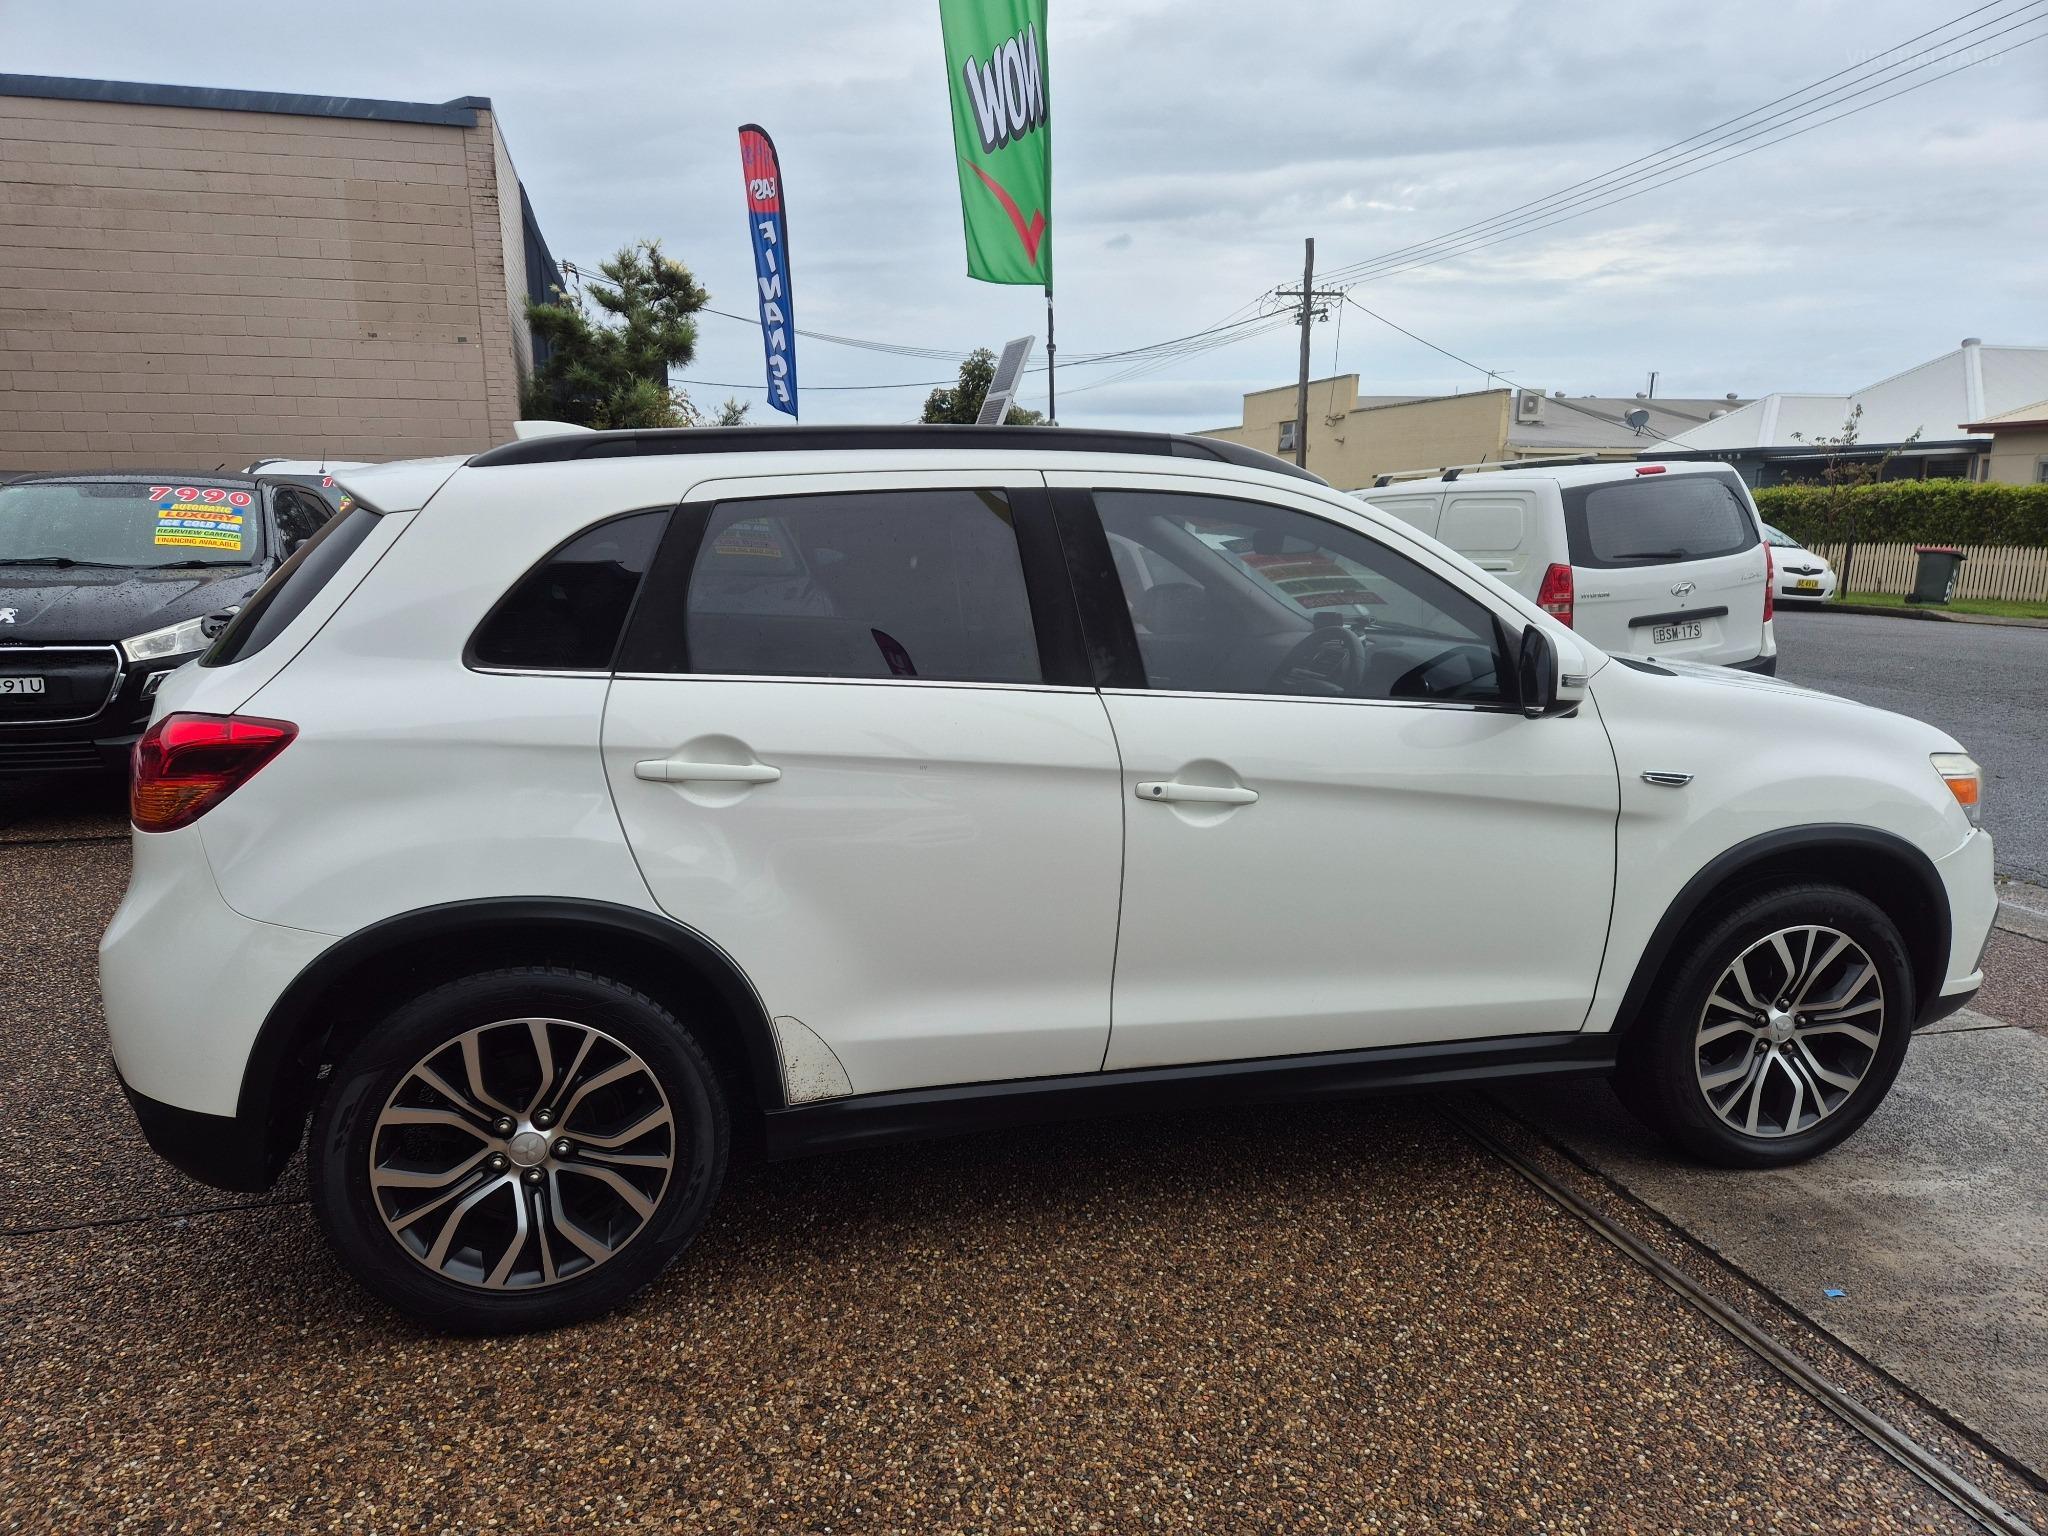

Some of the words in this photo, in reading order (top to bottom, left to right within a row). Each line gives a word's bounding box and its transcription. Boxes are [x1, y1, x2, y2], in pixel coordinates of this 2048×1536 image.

[149, 486, 252, 507] 7990
[170, 503, 234, 514] AUTOMATIC
[164, 511, 235, 521] LUXURY
[159, 519, 182, 527] ICE
[183, 520, 217, 529] COLD
[217, 523, 240, 532] AIR
[157, 528, 202, 536] REARVIEW
[203, 531, 240, 540] CAMERA
[157, 537, 197, 545] FINANCING
[199, 539, 239, 549] AVAILABLE
[0, 679, 43, 693] 91U
